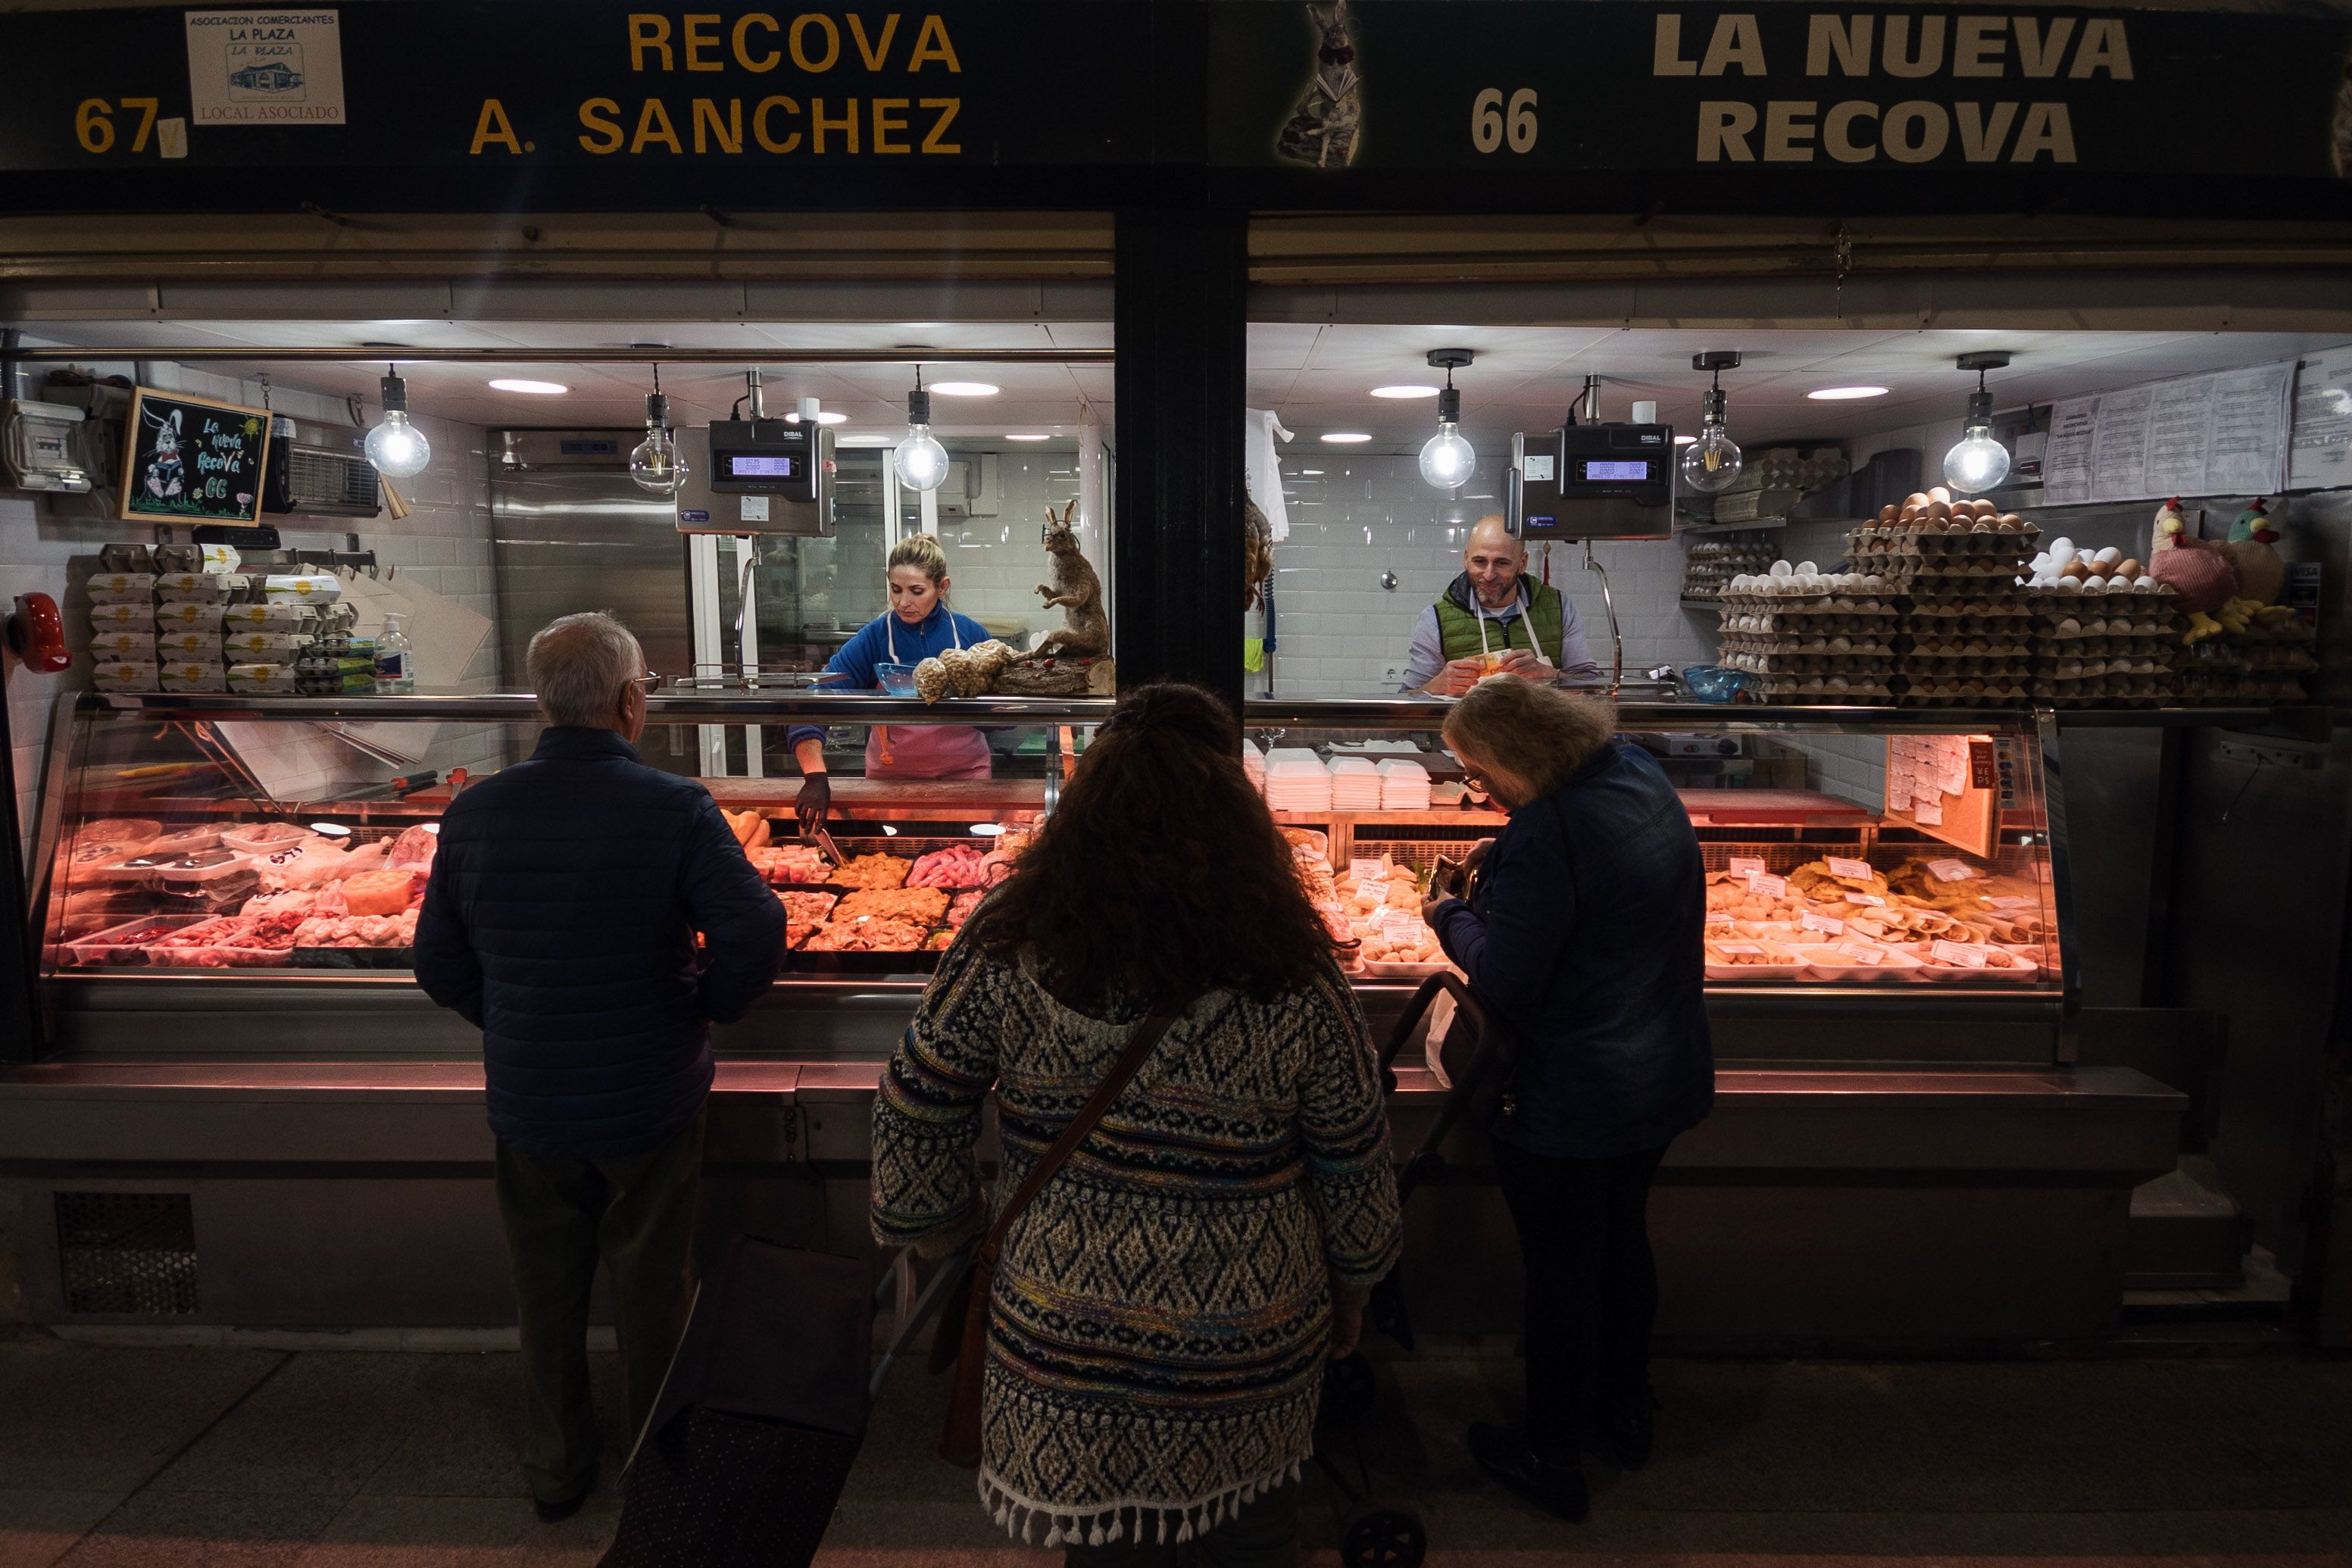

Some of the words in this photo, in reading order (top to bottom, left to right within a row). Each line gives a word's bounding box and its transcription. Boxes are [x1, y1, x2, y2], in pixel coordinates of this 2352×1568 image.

[190, 17, 253, 26] ASOCIACION
[257, 15, 335, 24] COMERCIANTES
[230, 29, 246, 41] LA
[252, 29, 295, 40] PLAZA
[231, 46, 247, 55] LA
[255, 46, 293, 55] PLAZA
[628, 13, 961, 73] RECOVA
[1653, 14, 1767, 77] LA
[1806, 14, 2135, 80] NUEVA
[77, 98, 158, 154] 67
[201, 107, 254, 120] LOCAL
[258, 106, 339, 120] ASOCIADO
[470, 98, 536, 155] A.
[579, 96, 961, 155] SANCHEZ
[1472, 87, 1538, 154] 66
[1696, 100, 2078, 164] RECOVA
[203, 419, 218, 433] La
[205, 476, 227, 498] 66
